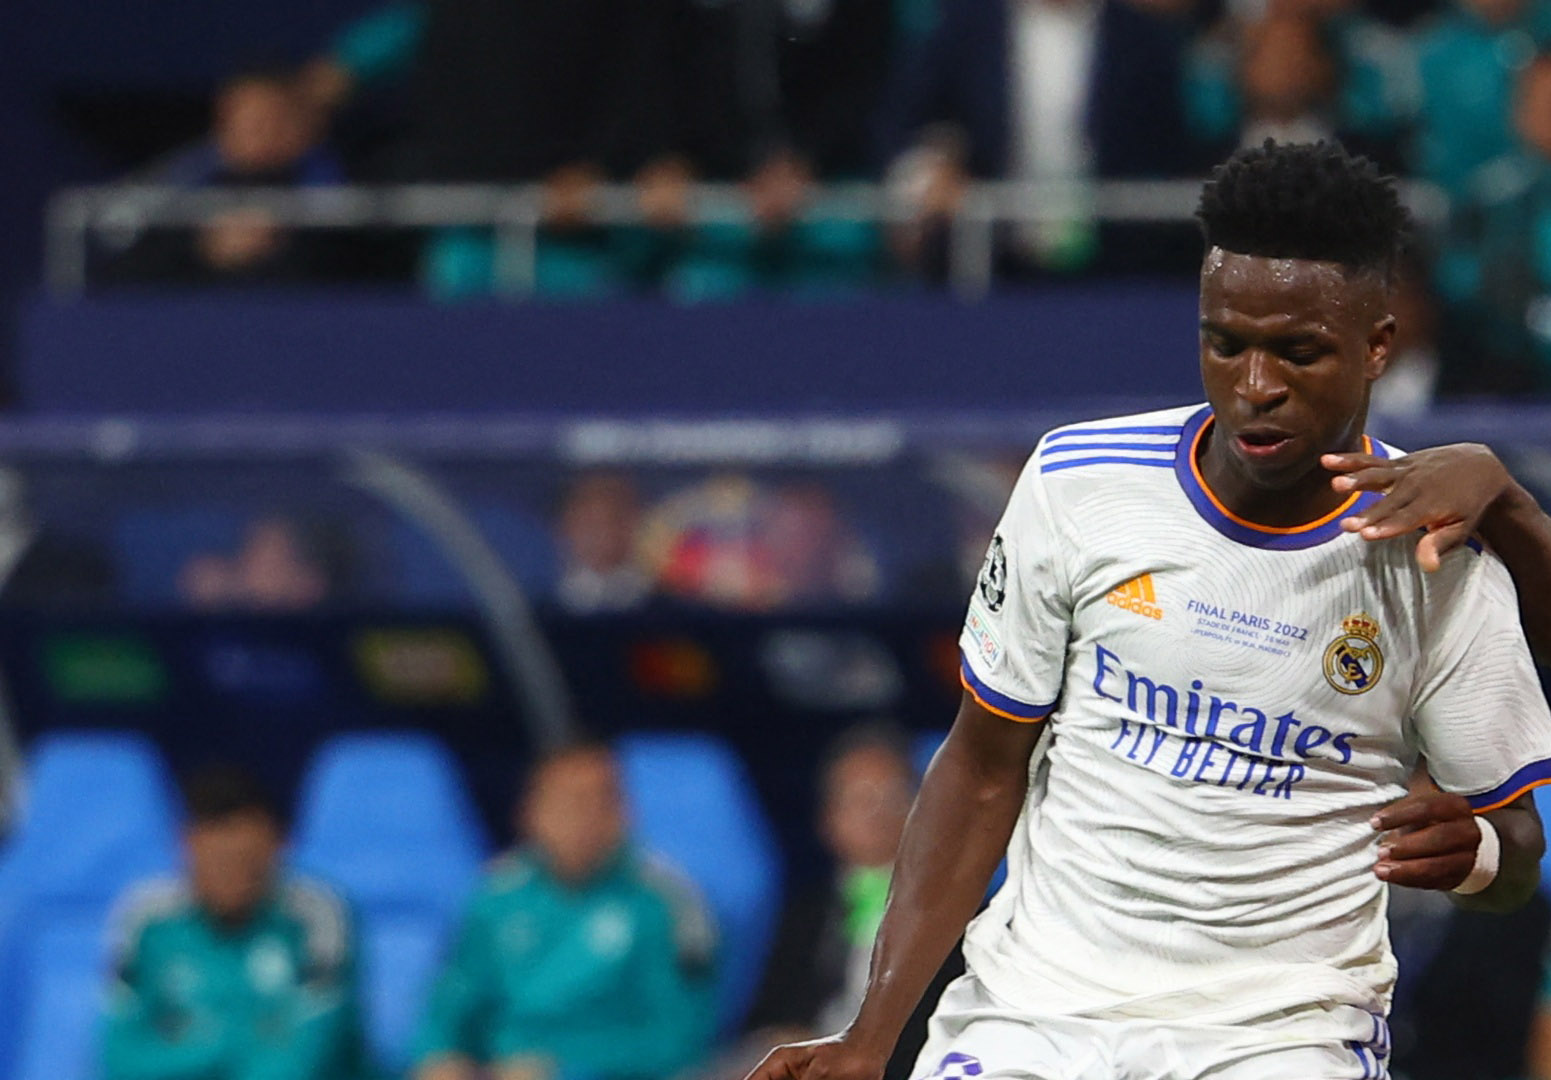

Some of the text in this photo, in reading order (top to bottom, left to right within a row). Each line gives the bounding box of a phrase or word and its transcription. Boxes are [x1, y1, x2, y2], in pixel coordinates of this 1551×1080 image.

[1105, 592, 1164, 621] adidas
[1187, 600, 1309, 641] FINAL PARIS 2022
[1093, 643, 1359, 764] Emirates
[1111, 718, 1305, 799] FLY BETTER
